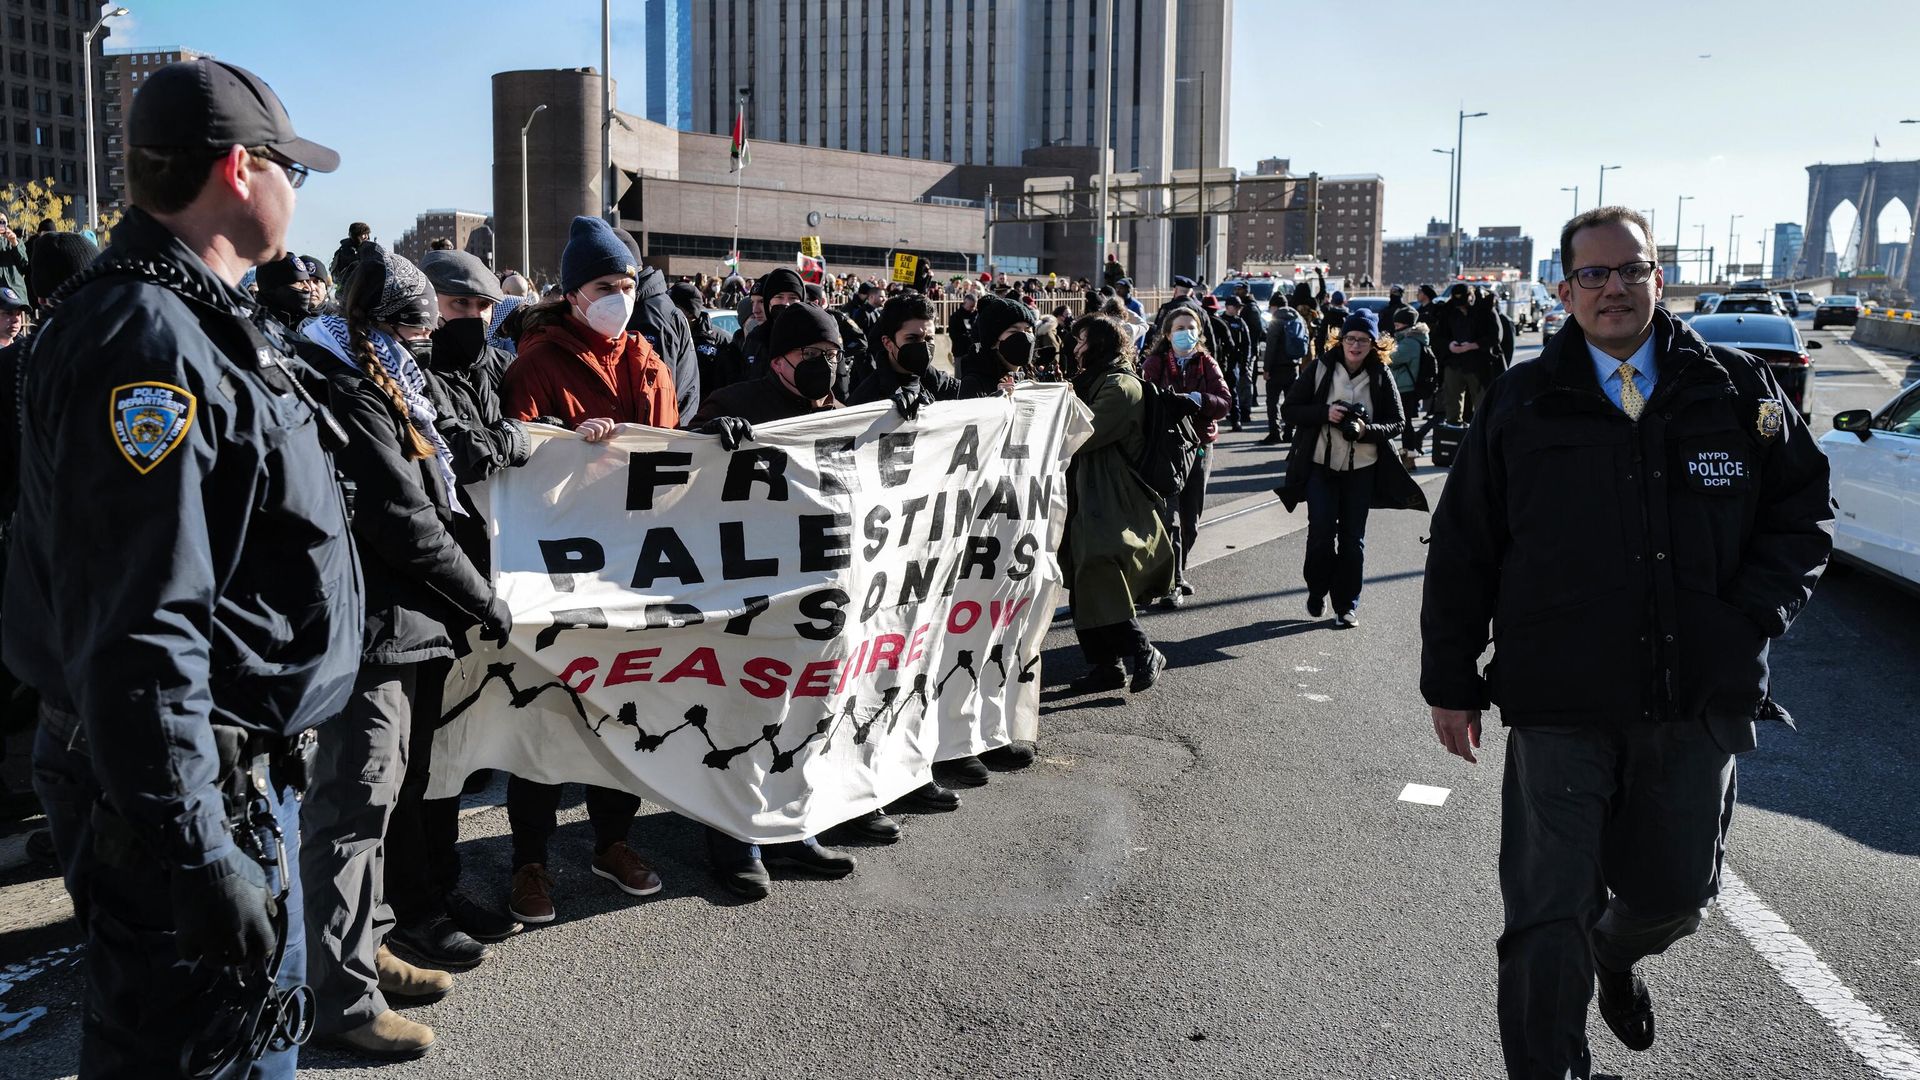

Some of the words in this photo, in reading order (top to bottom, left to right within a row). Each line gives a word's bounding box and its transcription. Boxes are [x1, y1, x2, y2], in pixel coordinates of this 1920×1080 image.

[117, 396, 187, 414] DEPARTMENT
[133, 388, 174, 400] POLICE
[115, 421, 129, 442] CITY
[124, 443, 138, 457] OF
[149, 441, 168, 461] NEW
[165, 417, 187, 441] YORK
[1688, 461, 1744, 476] POLICE
[1698, 452, 1729, 460] NYPD
[626, 431, 918, 511] FREE
[1703, 478, 1731, 486] DCPI
[538, 474, 1053, 593] PALESTINAN
[946, 597, 1030, 635] OW
